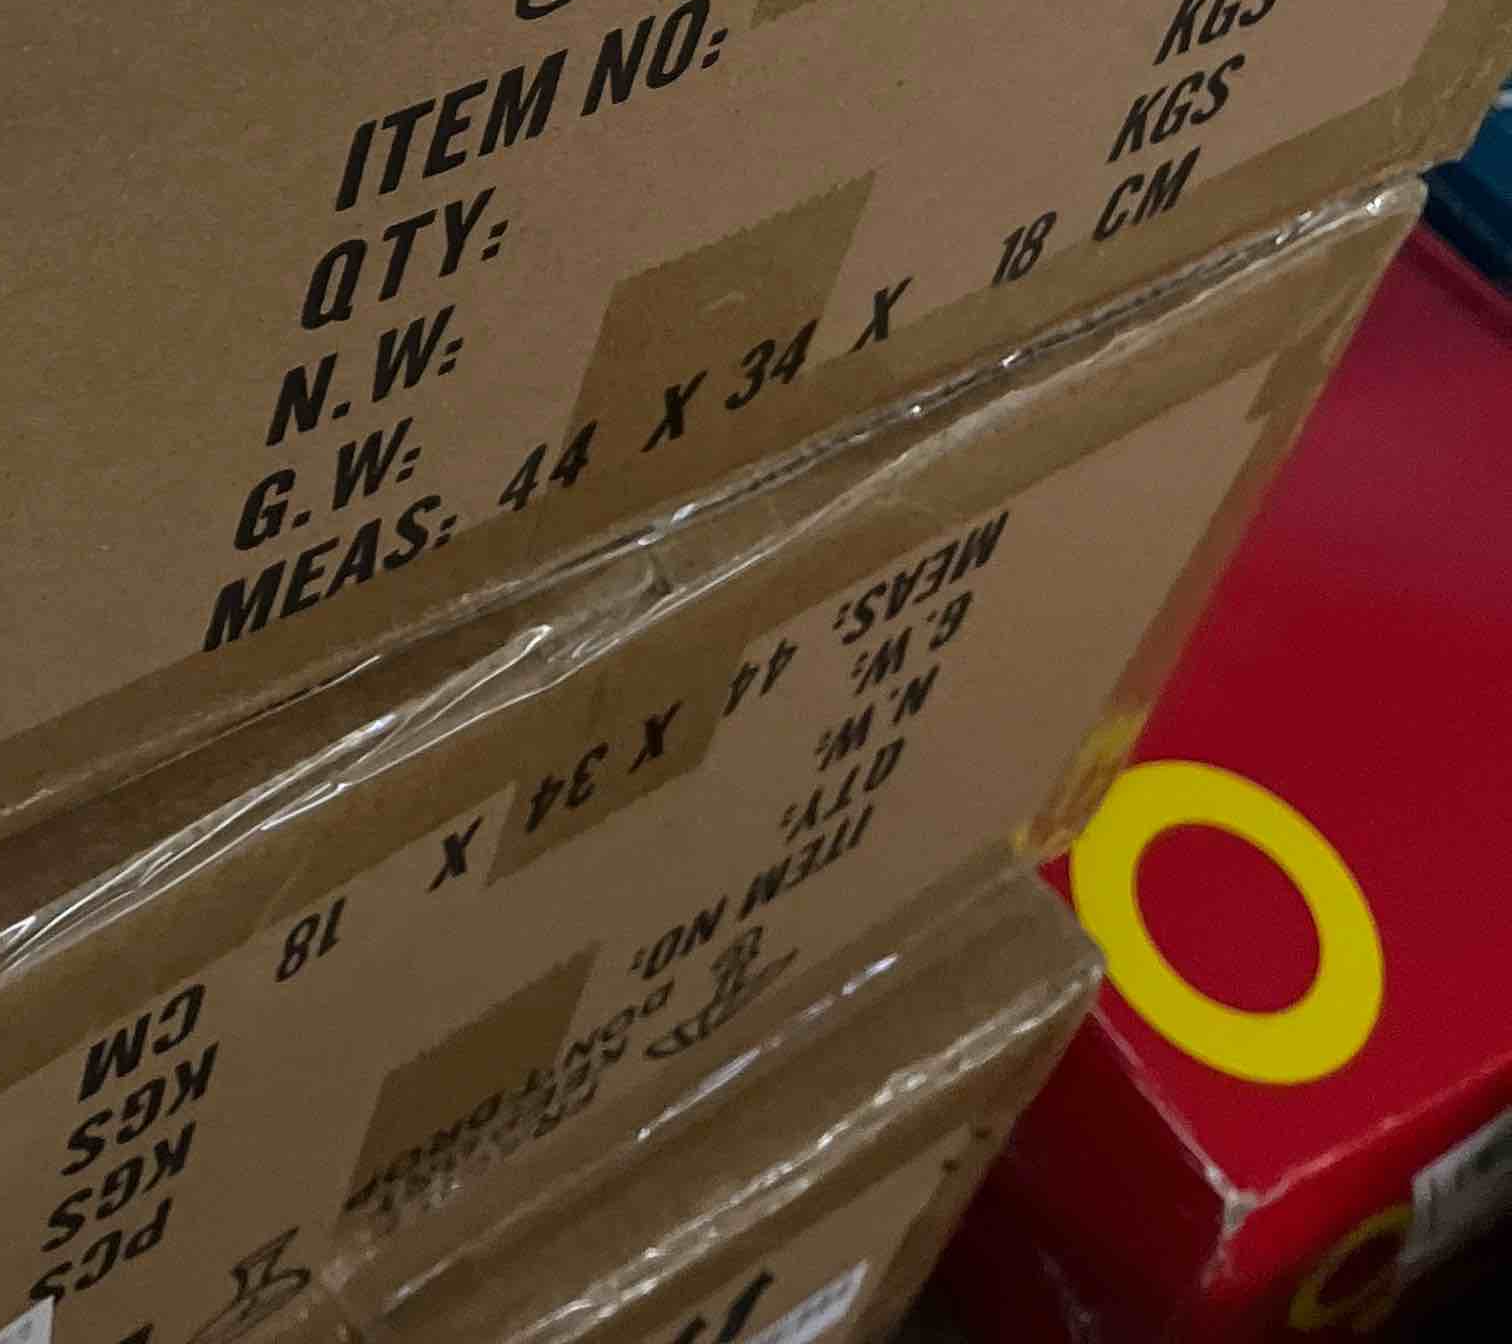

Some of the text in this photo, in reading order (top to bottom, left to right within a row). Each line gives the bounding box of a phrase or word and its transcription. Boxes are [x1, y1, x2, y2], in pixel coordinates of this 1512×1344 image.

[336, 50, 567, 211] ITEM
[1108, 54, 1245, 162] KGS
[302, 187, 508, 329] QTY:
[203, 147, 1200, 652] MEAS: 44 X 34 X 18 CM
[79, 510, 1009, 1102] MEAS: 44 X 34 X 18 CM
[630, 804, 875, 980] ITEM NO:
[29, 737, 906, 1303] QTY: PCS
[41, 1121, 196, 1252] KGS
[61, 1042, 219, 1176] KGS
